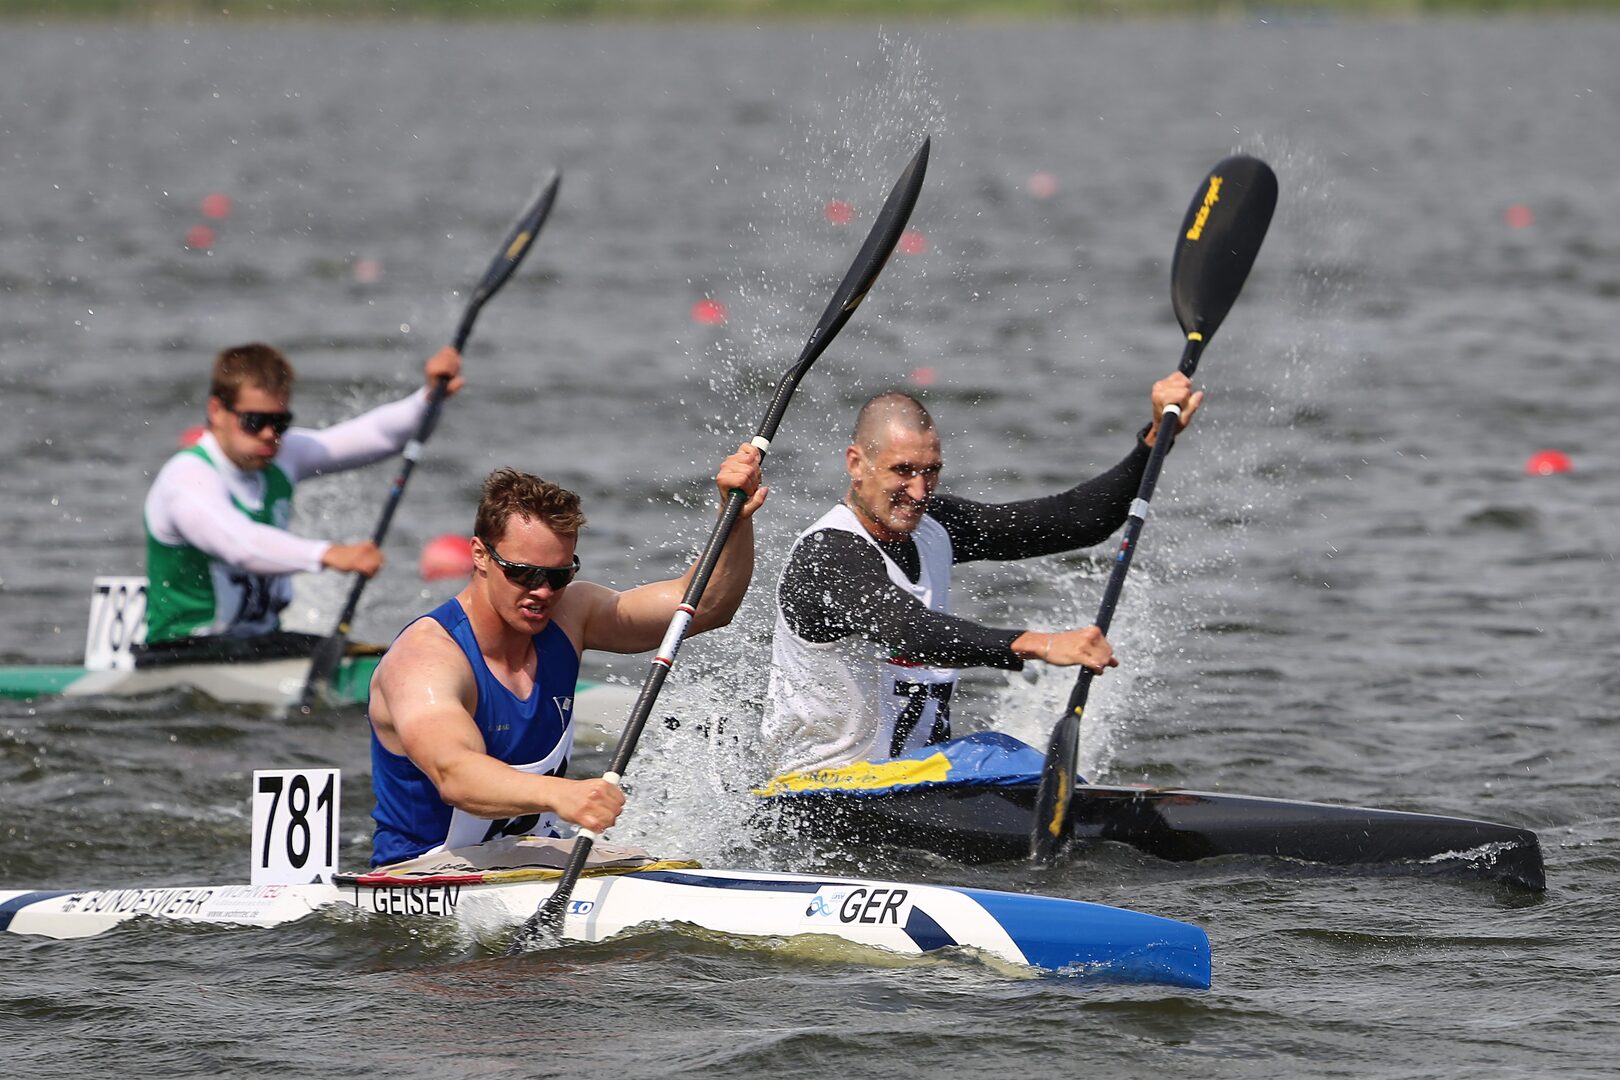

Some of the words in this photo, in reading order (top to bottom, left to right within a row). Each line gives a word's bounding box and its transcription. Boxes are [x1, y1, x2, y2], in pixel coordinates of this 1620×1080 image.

[259, 773, 334, 869] 781
[83, 889, 213, 914] BUNDESWEHR
[373, 886, 460, 916] GEISEN
[840, 888, 908, 924] GER
